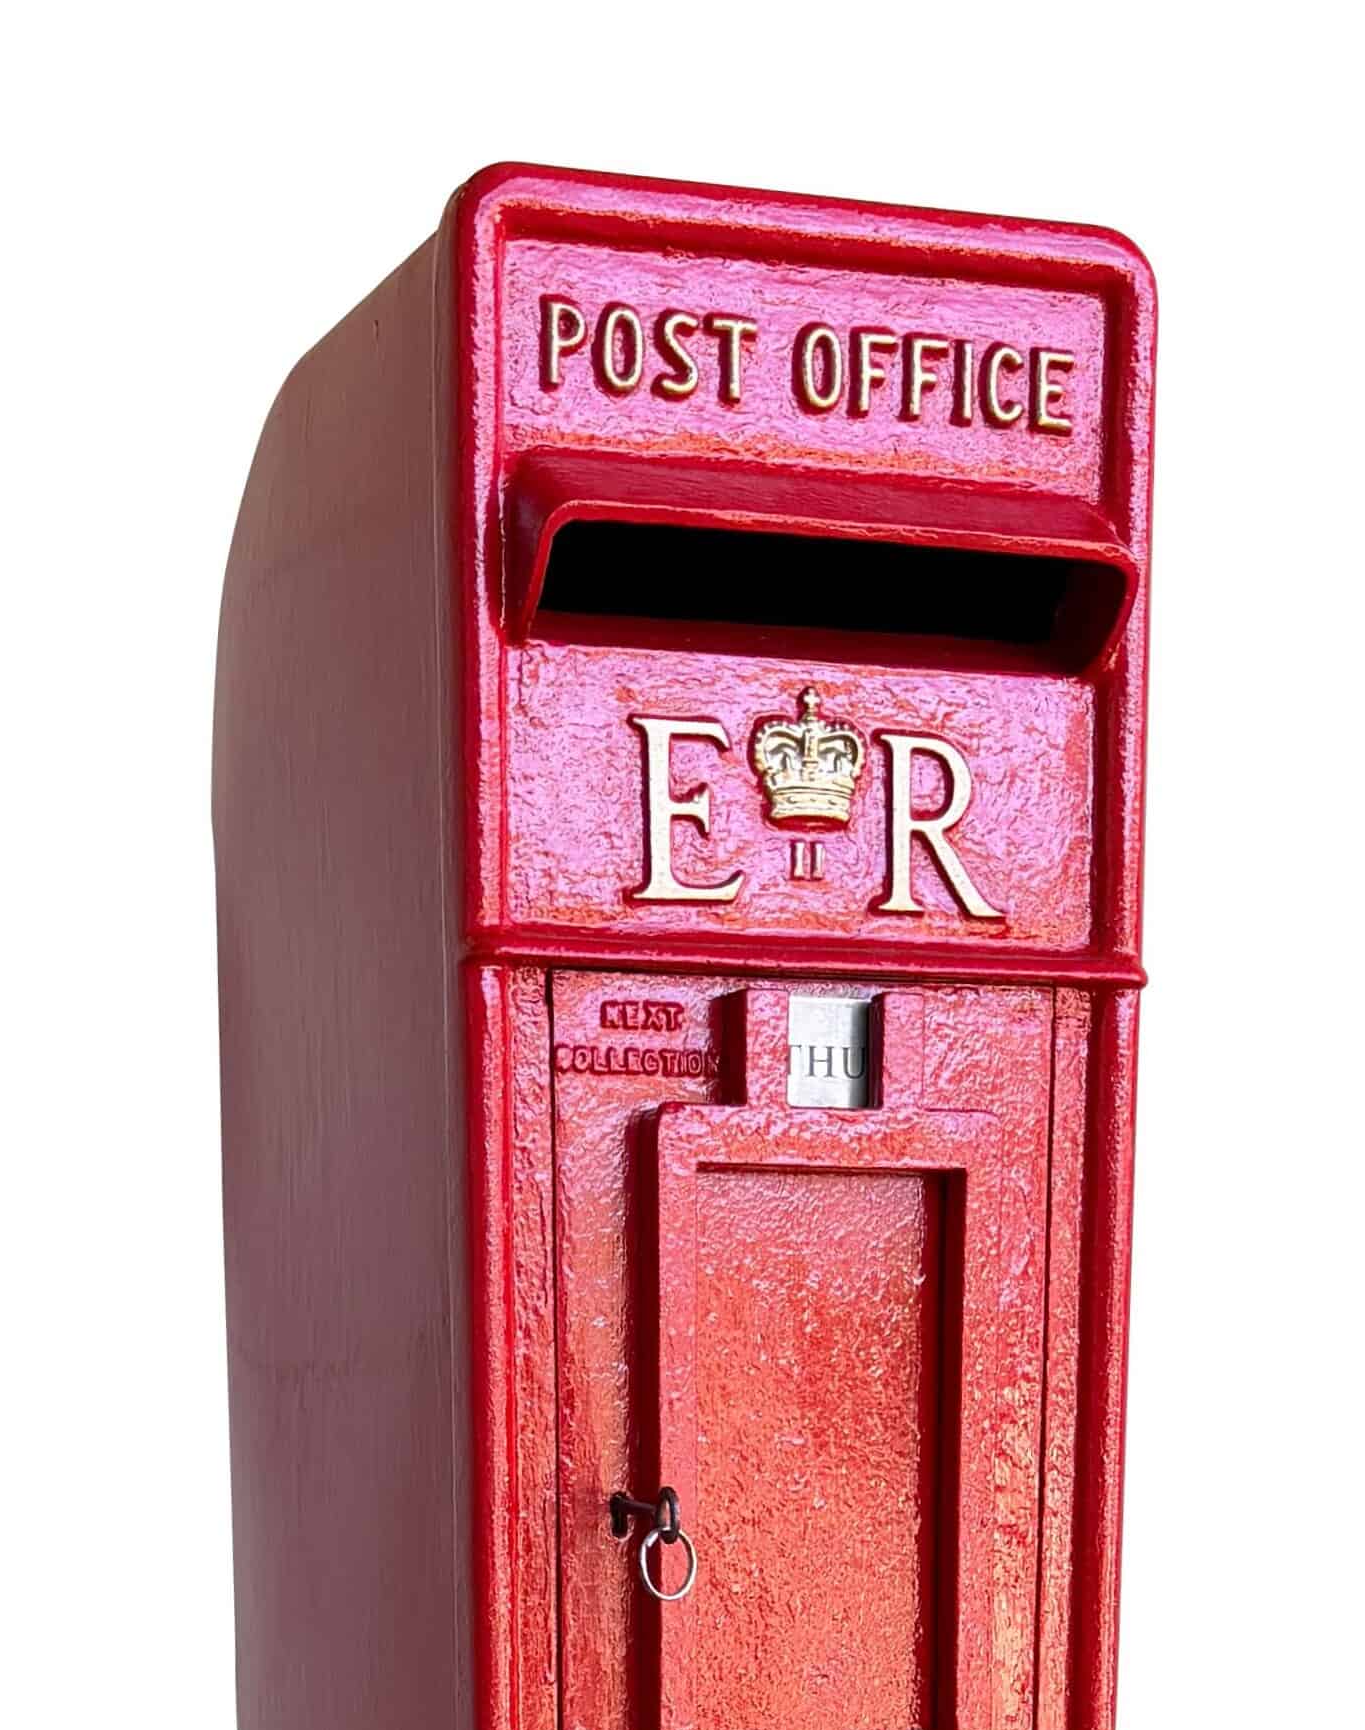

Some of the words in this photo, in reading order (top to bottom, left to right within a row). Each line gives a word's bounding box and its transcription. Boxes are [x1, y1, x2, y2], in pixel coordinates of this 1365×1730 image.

[541, 297, 757, 404] POST
[794, 325, 1075, 434] OFFICE
[630, 715, 745, 901] E
[872, 731, 1005, 919] R
[600, 1001, 684, 1031] NEXT
